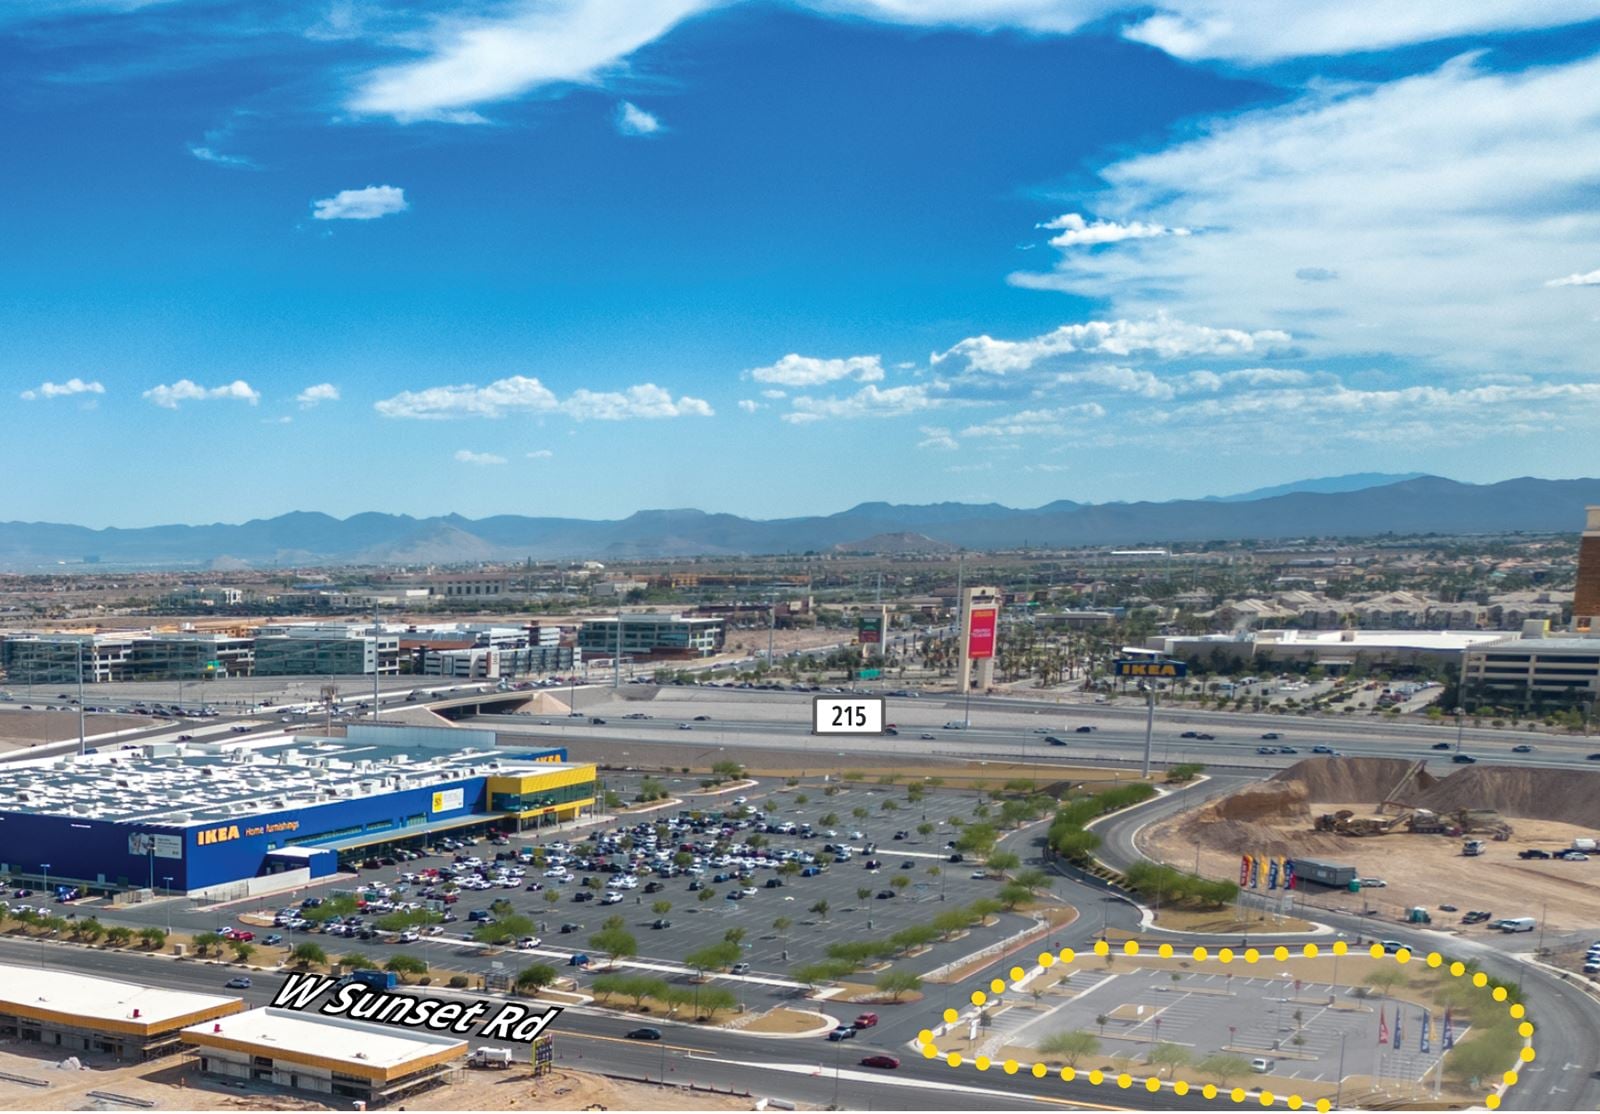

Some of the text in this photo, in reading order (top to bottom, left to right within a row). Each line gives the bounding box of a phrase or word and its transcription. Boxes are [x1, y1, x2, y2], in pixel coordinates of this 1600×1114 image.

[1122, 664, 1176, 676] IKEA
[197, 825, 240, 846] IKEA
[245, 827, 264, 837] Home
